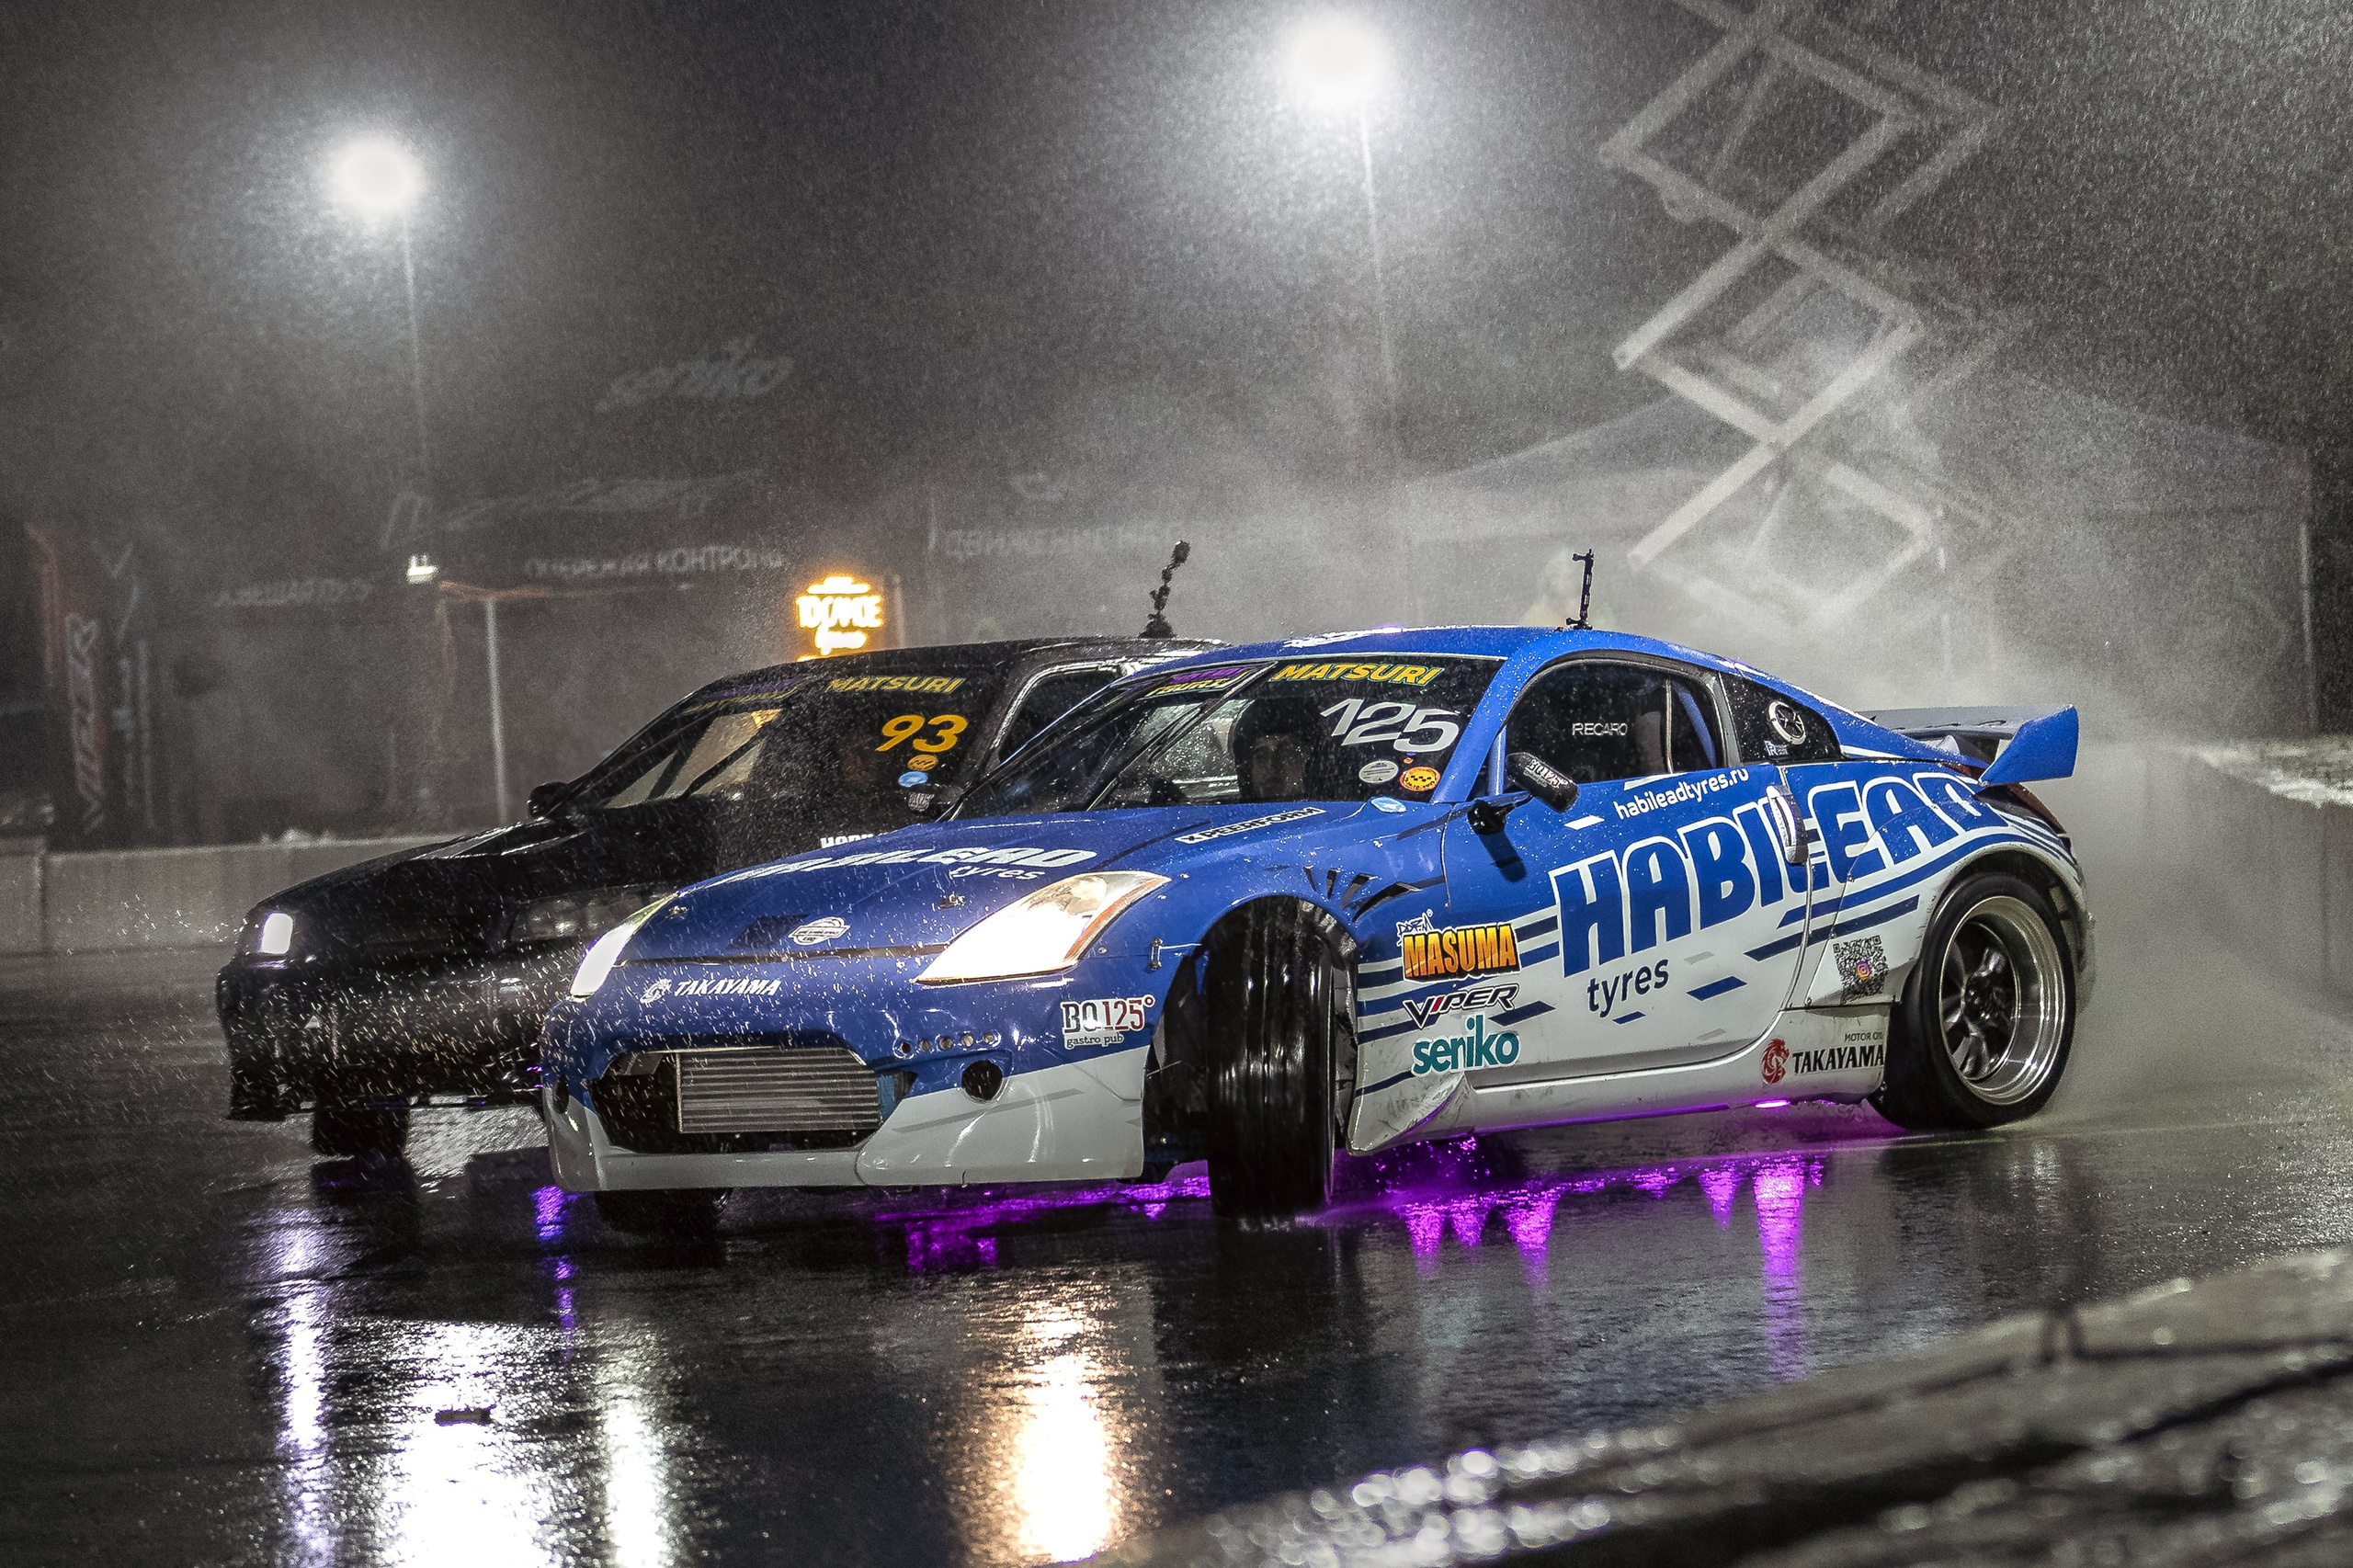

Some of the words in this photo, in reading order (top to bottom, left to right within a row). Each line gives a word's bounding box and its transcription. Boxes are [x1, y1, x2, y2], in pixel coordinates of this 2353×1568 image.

[826, 676, 967, 694] MATSURI
[1269, 663, 1444, 686] MATSURI
[875, 714, 969, 753] 93
[1320, 699, 1460, 753] 125
[1572, 722, 1628, 736] RECARO
[1613, 767, 1750, 820] habileadtyres.ru
[949, 866, 1045, 880] tyres
[1403, 925, 1518, 979] MASUMA
[674, 979, 781, 996] TAKAYAMA
[1586, 959, 1669, 1018] tyres
[1404, 984, 1518, 1029] VIPER
[1066, 1036, 1101, 1048] gastro
[1104, 1033, 1123, 1045] pub
[1413, 1015, 1519, 1075] seniko
[1844, 1032, 1871, 1042] MOTOR
[1792, 1044, 1883, 1074] TAKAYAMA
